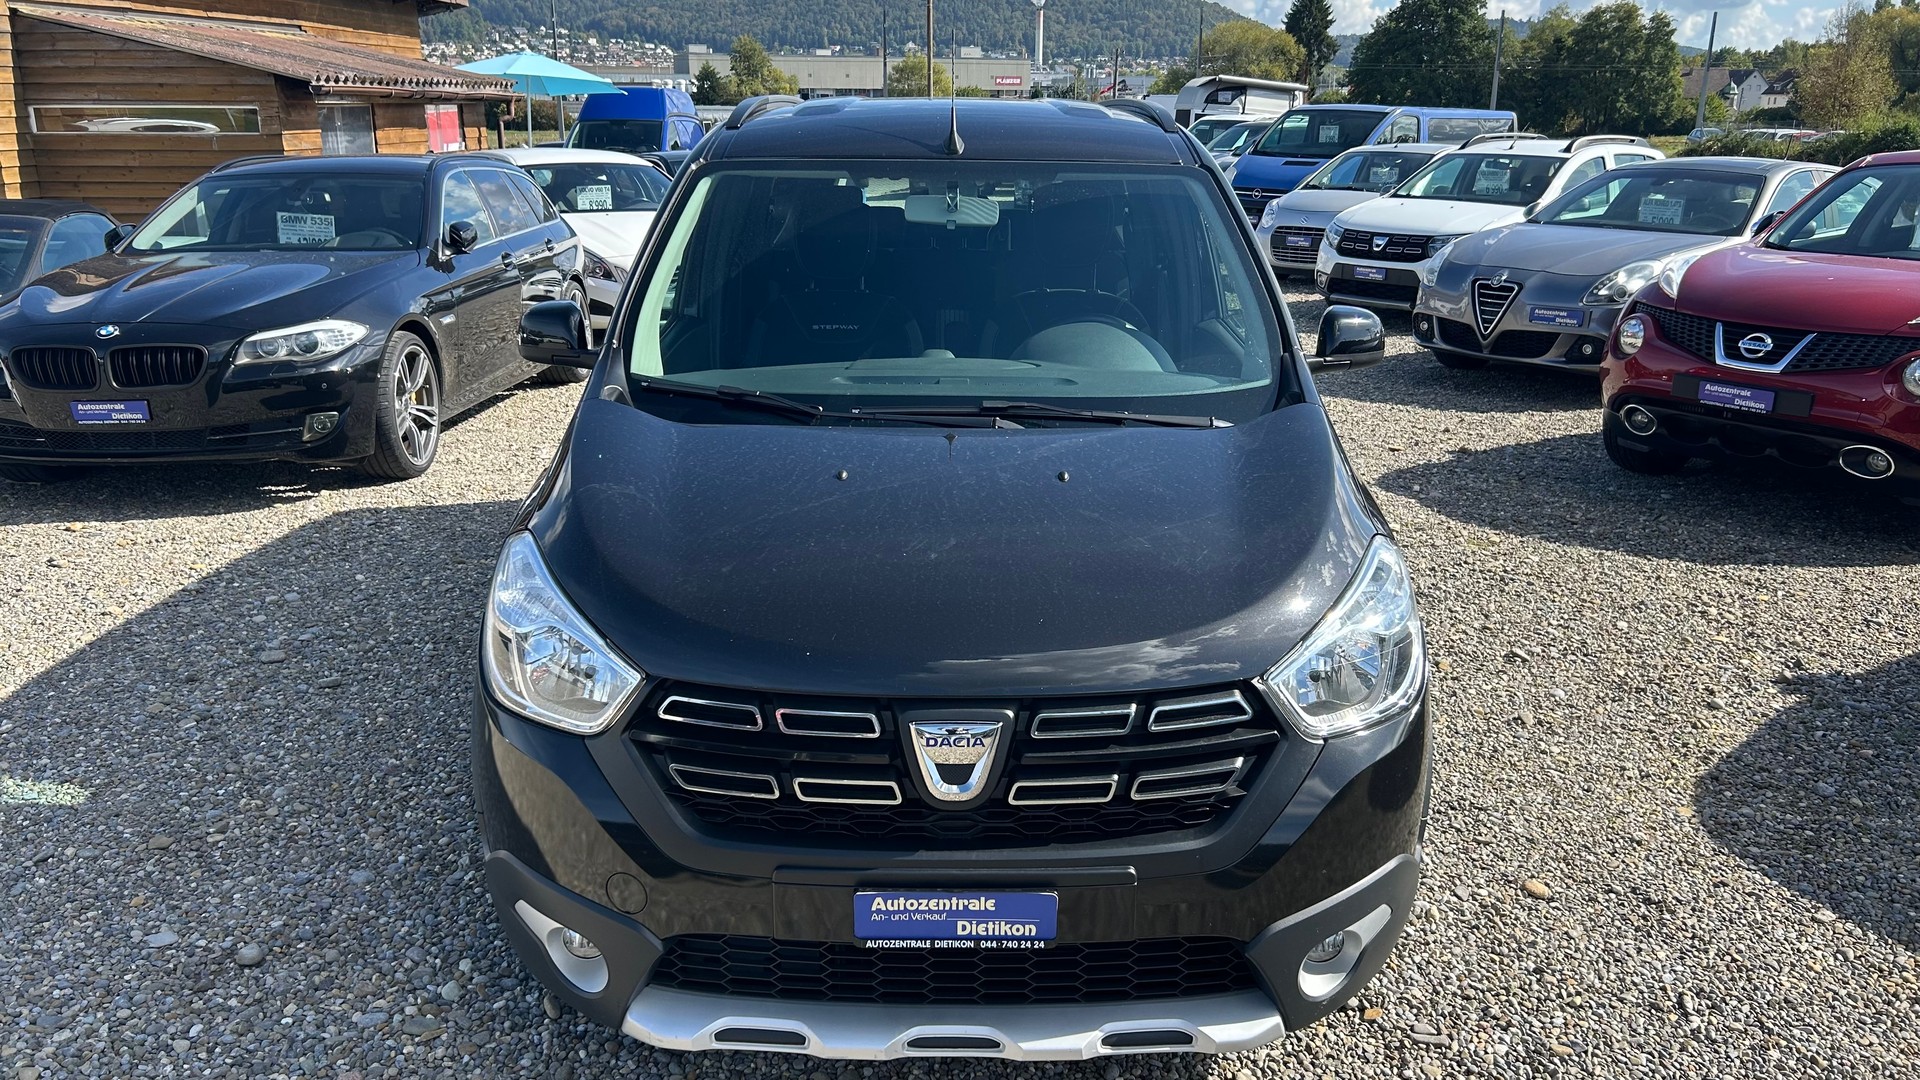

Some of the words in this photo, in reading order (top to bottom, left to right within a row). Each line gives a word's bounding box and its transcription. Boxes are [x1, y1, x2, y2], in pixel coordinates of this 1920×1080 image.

[280, 214, 308, 225] BMW
[310, 216, 333, 227] 535i
[1741, 341, 1768, 349] NISSAN
[1704, 383, 1752, 397] Autozentrale
[1734, 398, 1765, 409] Dietikon
[111, 412, 143, 420] Dietikon
[925, 736, 986, 748] DACIA
[870, 896, 996, 911] Autozentrale
[870, 912, 889, 921] An-
[890, 912, 909, 921] und
[911, 912, 947, 921] Verkauf
[956, 921, 1037, 936] Dietikon
[865, 939, 931, 949] AUTOZENTRALE
[934, 939, 974, 949] DIETIKON
[1020, 940, 1031, 949] 24
[1033, 940, 1045, 949] 24
